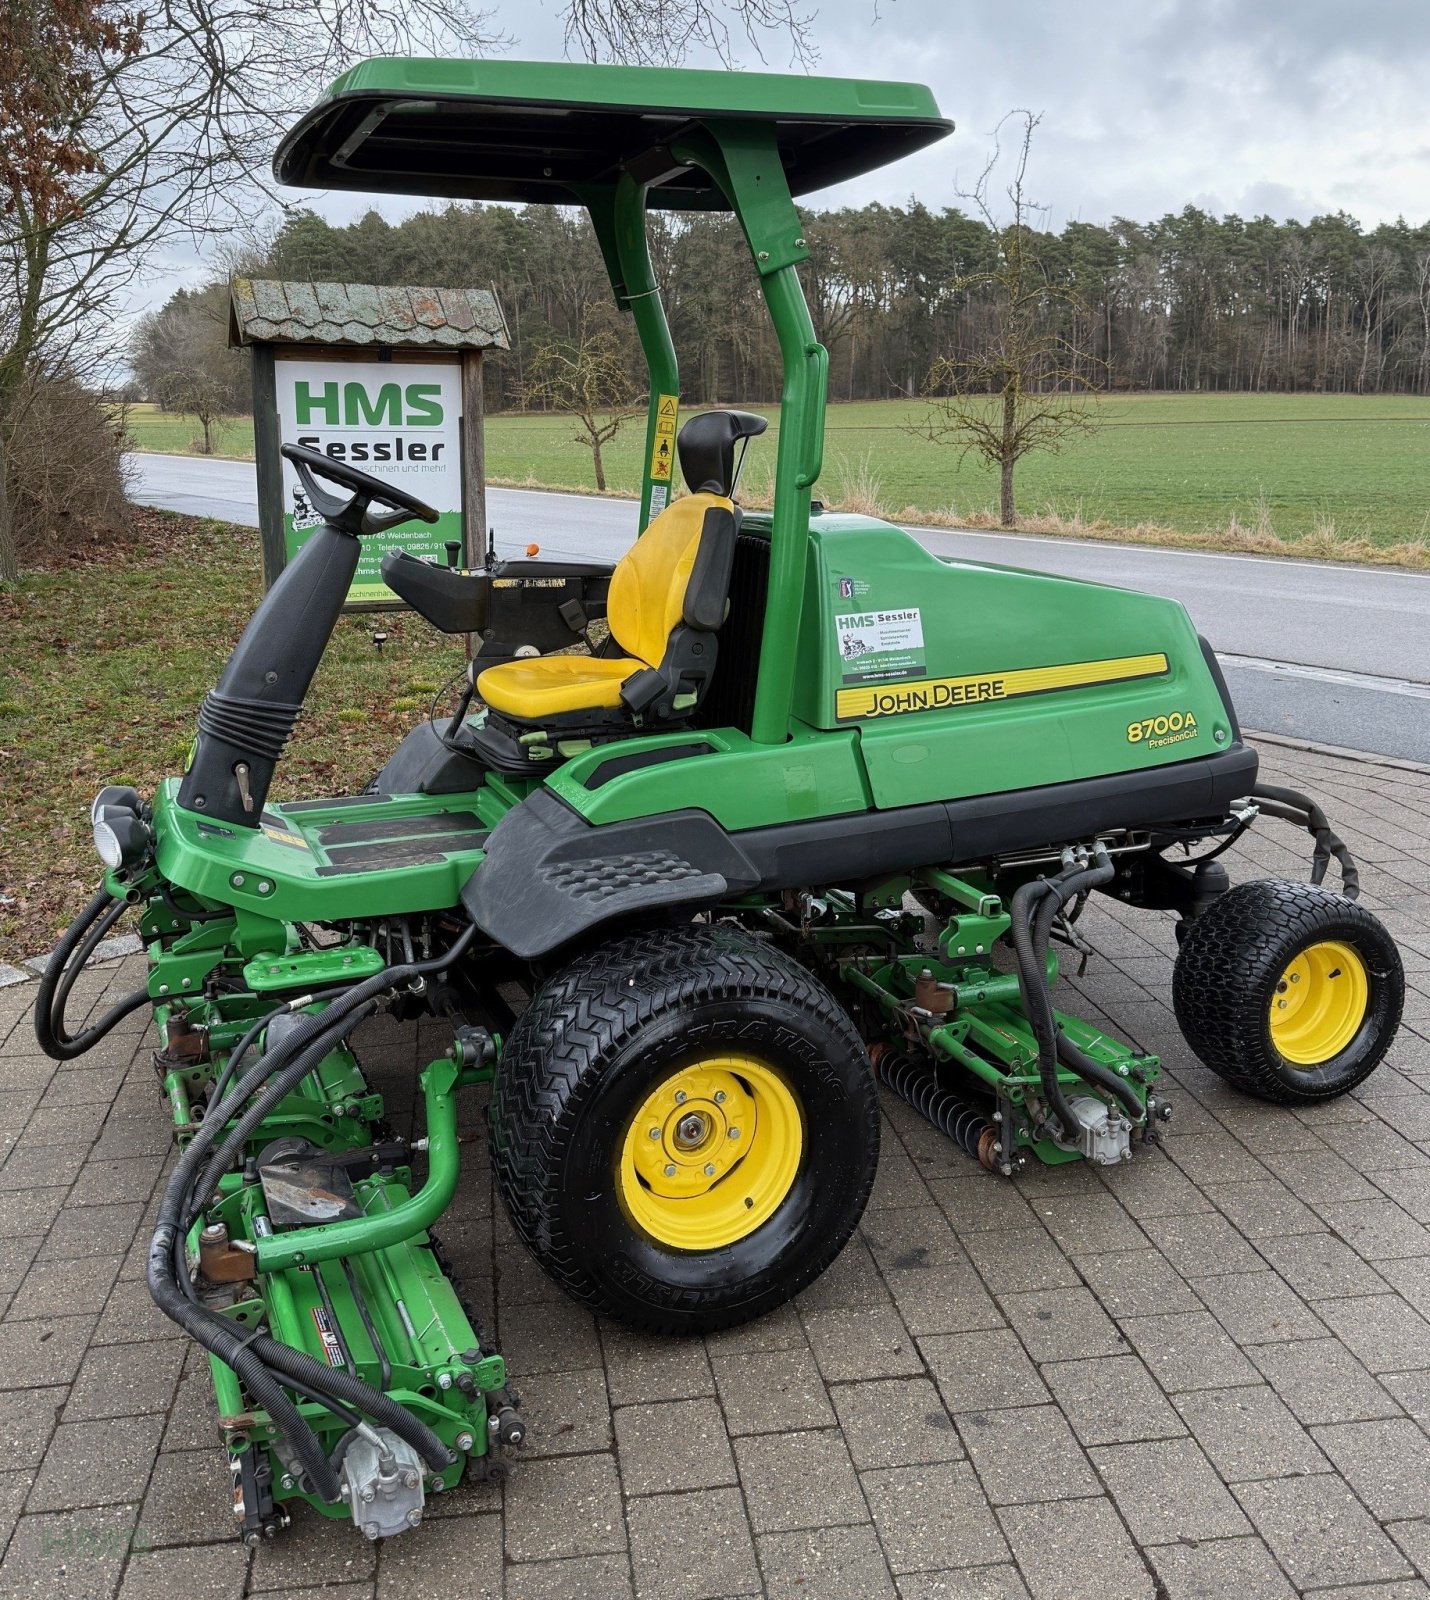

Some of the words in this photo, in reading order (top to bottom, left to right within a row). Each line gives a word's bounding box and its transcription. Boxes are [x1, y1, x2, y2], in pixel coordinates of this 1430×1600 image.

[295, 381, 444, 426] HMS
[298, 437, 445, 461] Sessler
[355, 464, 400, 473] aschinen
[402, 464, 419, 473] und
[421, 464, 447, 473] mehr!
[387, 531, 432, 540] Weidenbach
[838, 615, 875, 630] HMS
[877, 612, 918, 623] Sessler
[866, 690, 928, 715] JOHN
[932, 680, 1005, 705] DEERE
[1127, 711, 1197, 743] 8700A
[1149, 728, 1198, 749] PrecisionCut
